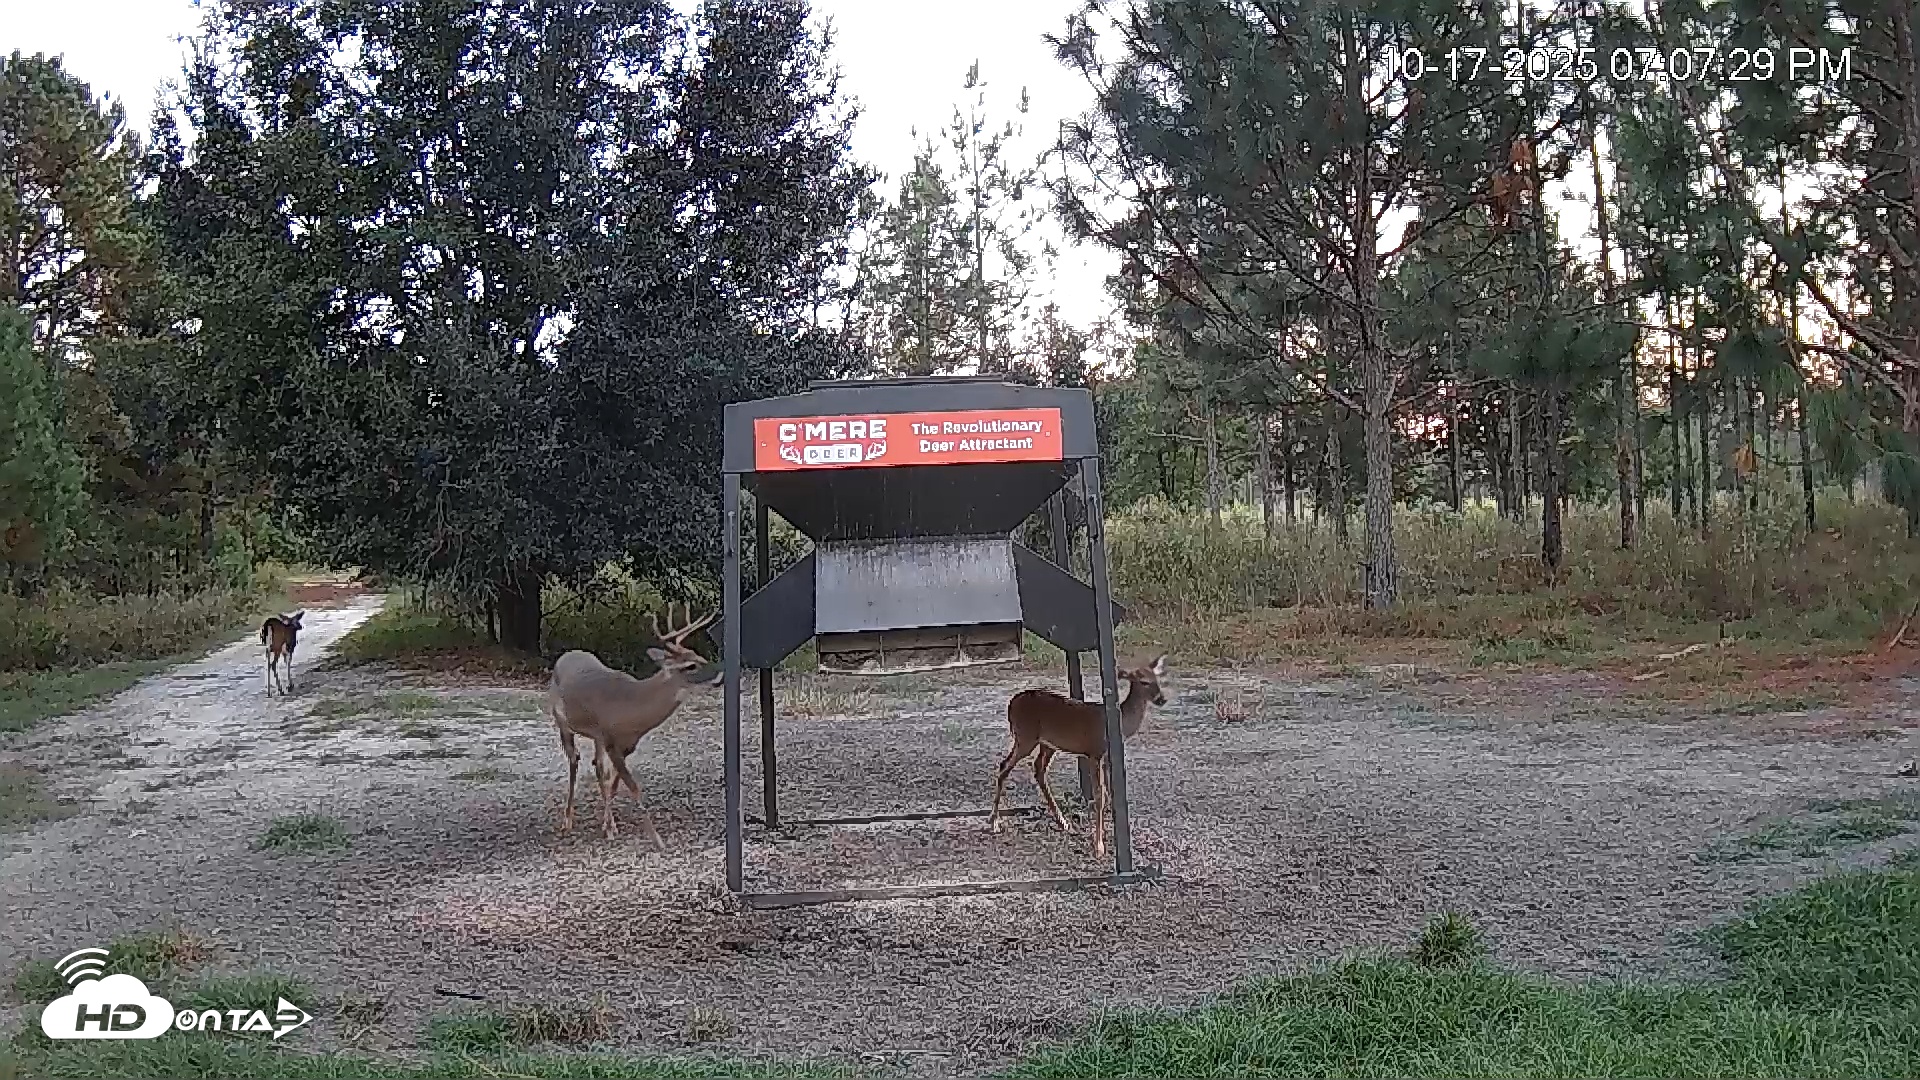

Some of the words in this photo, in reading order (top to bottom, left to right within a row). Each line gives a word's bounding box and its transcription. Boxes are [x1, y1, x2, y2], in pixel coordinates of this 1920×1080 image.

[779, 419, 887, 442] C'MERE
[911, 422, 938, 435] The
[943, 419, 1043, 434] Revolutionary
[919, 439, 955, 452] Deer
[959, 437, 1033, 450] Attractant
[809, 447, 858, 459] DEER
